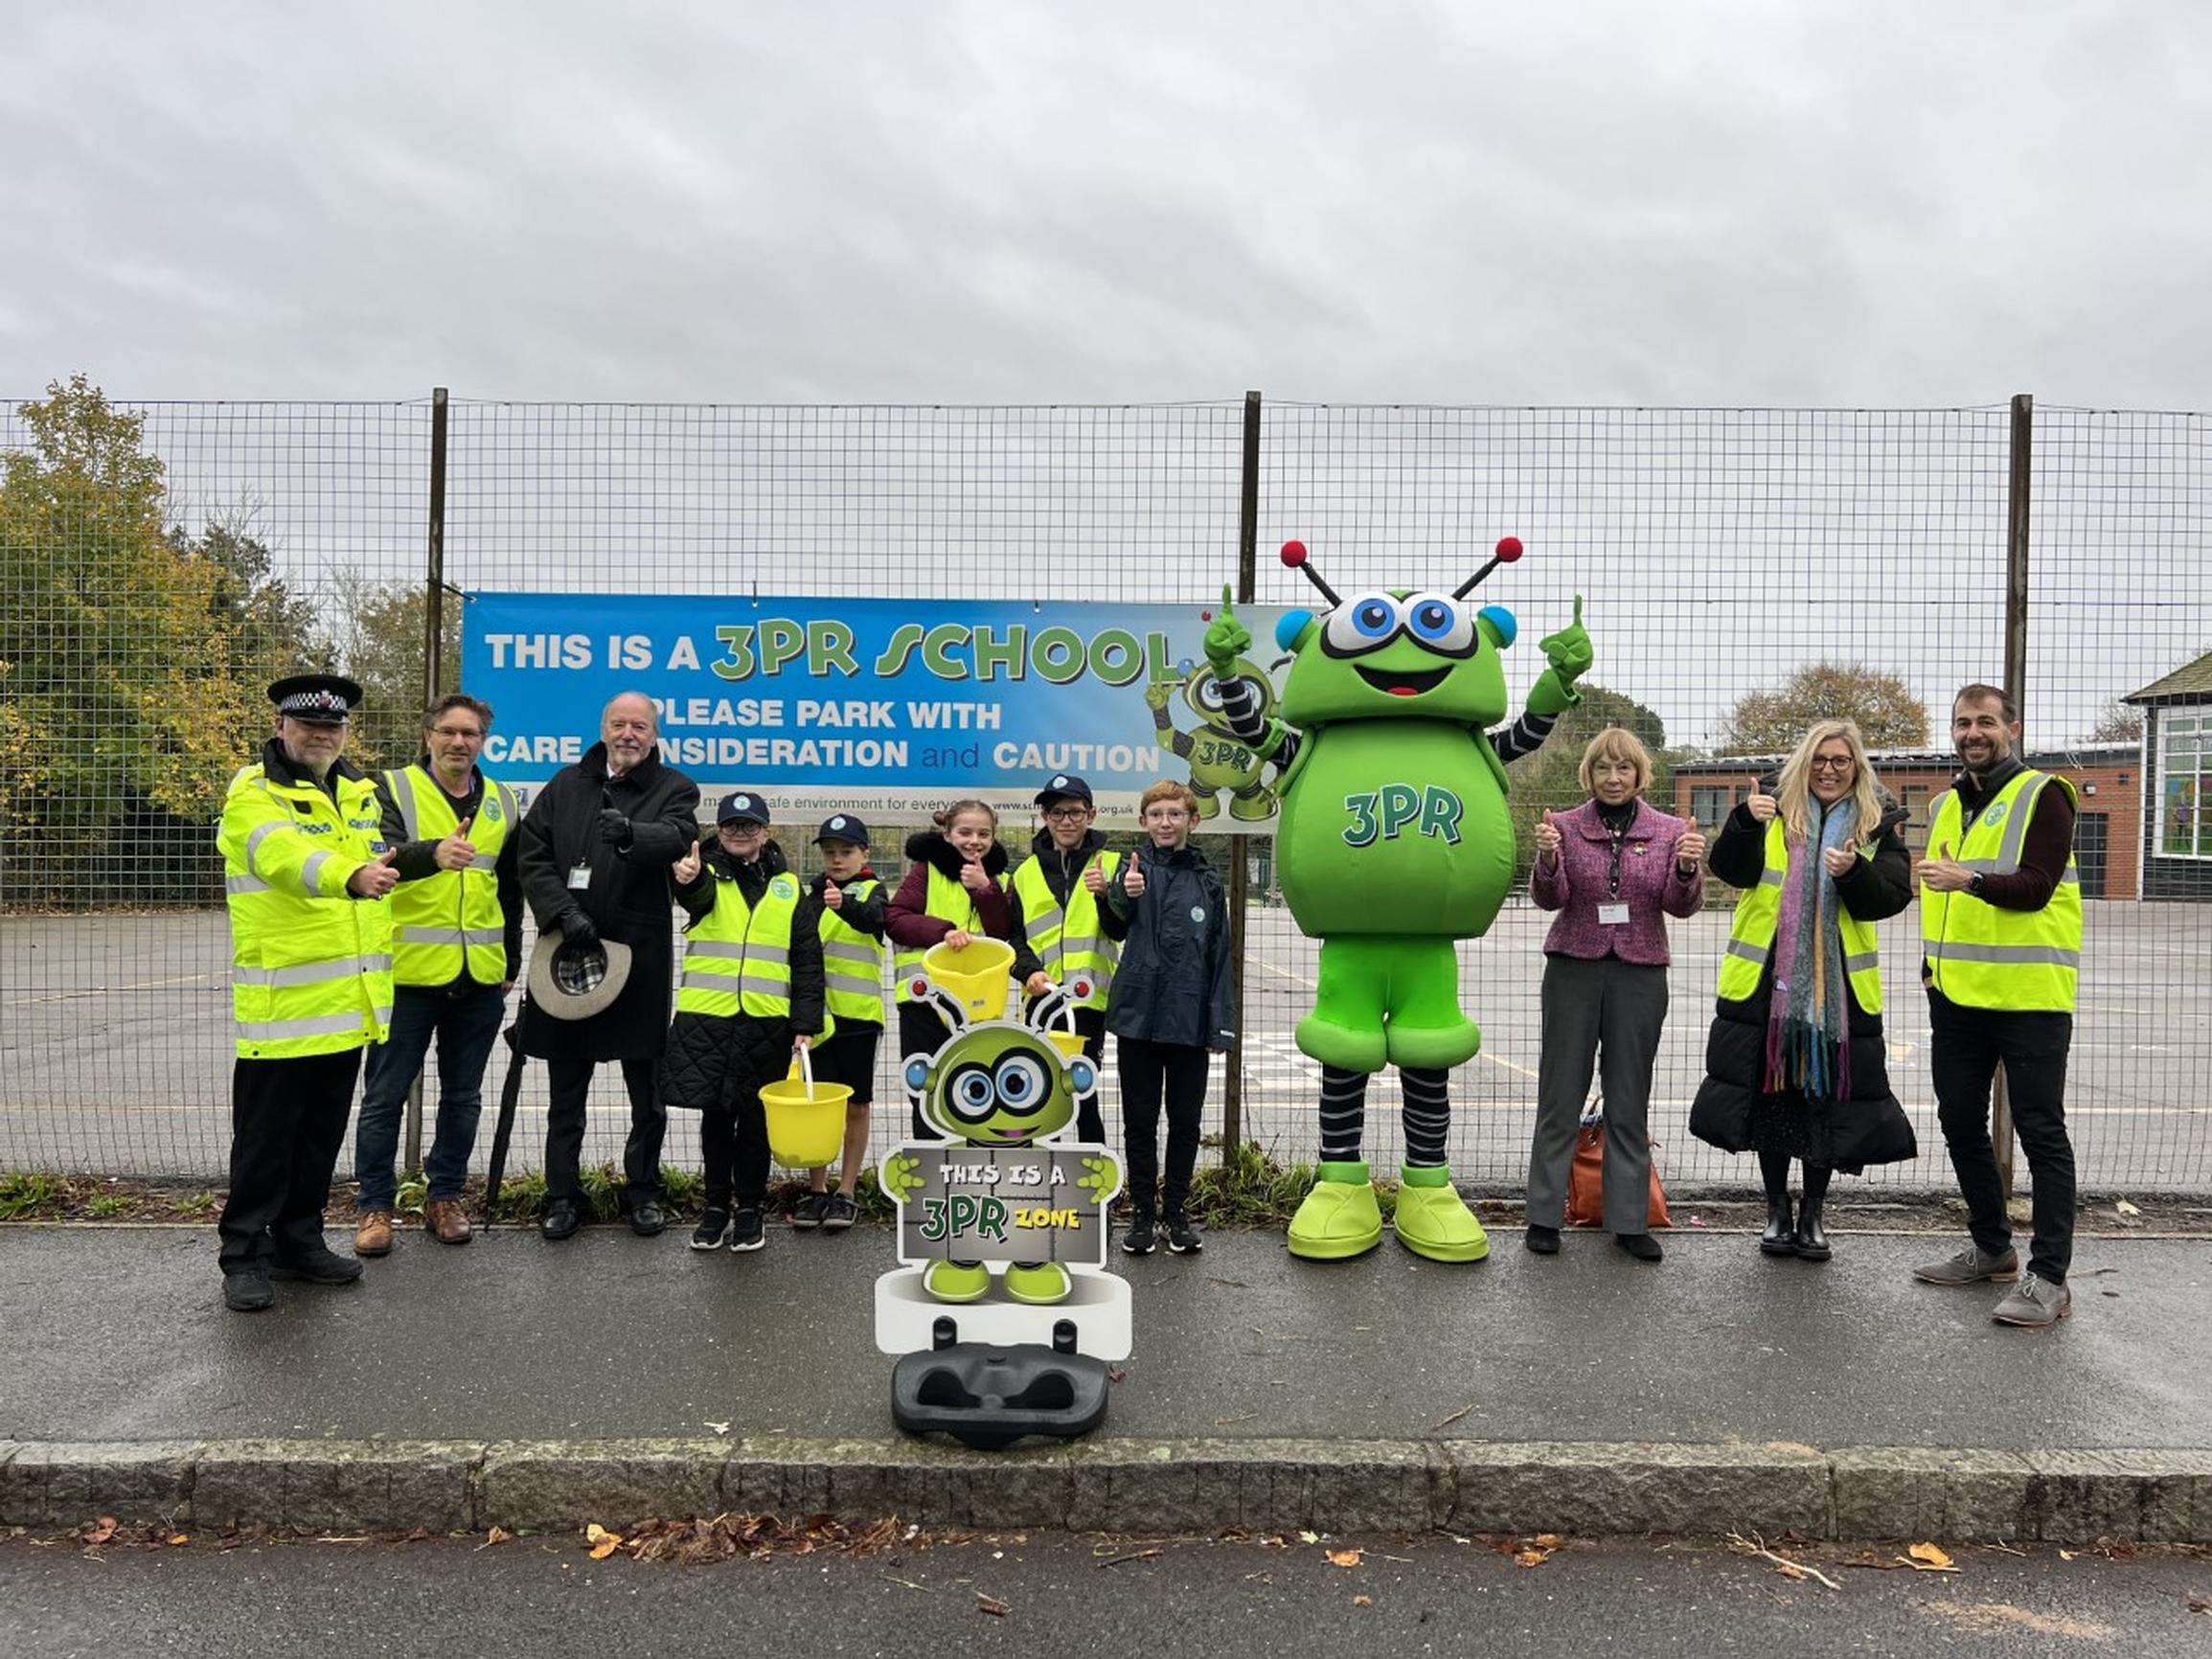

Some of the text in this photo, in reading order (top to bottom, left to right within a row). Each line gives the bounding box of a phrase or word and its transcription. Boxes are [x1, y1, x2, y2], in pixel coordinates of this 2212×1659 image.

[486, 618, 1187, 686] THIS IS A 3PR SCHOOL
[797, 700, 896, 728] PARK
[907, 701, 1001, 730] WITH
[483, 735, 1160, 772] CARE NSIDERATION and CAUTION
[1197, 741, 1251, 773] 3PR
[765, 796, 790, 808] afe
[794, 797, 882, 810] environment
[888, 797, 907, 810] for
[1341, 783, 1463, 847] 3PR
[940, 1164, 1067, 1187] THIS IS A
[920, 1193, 1081, 1243] 3PR ZONE
